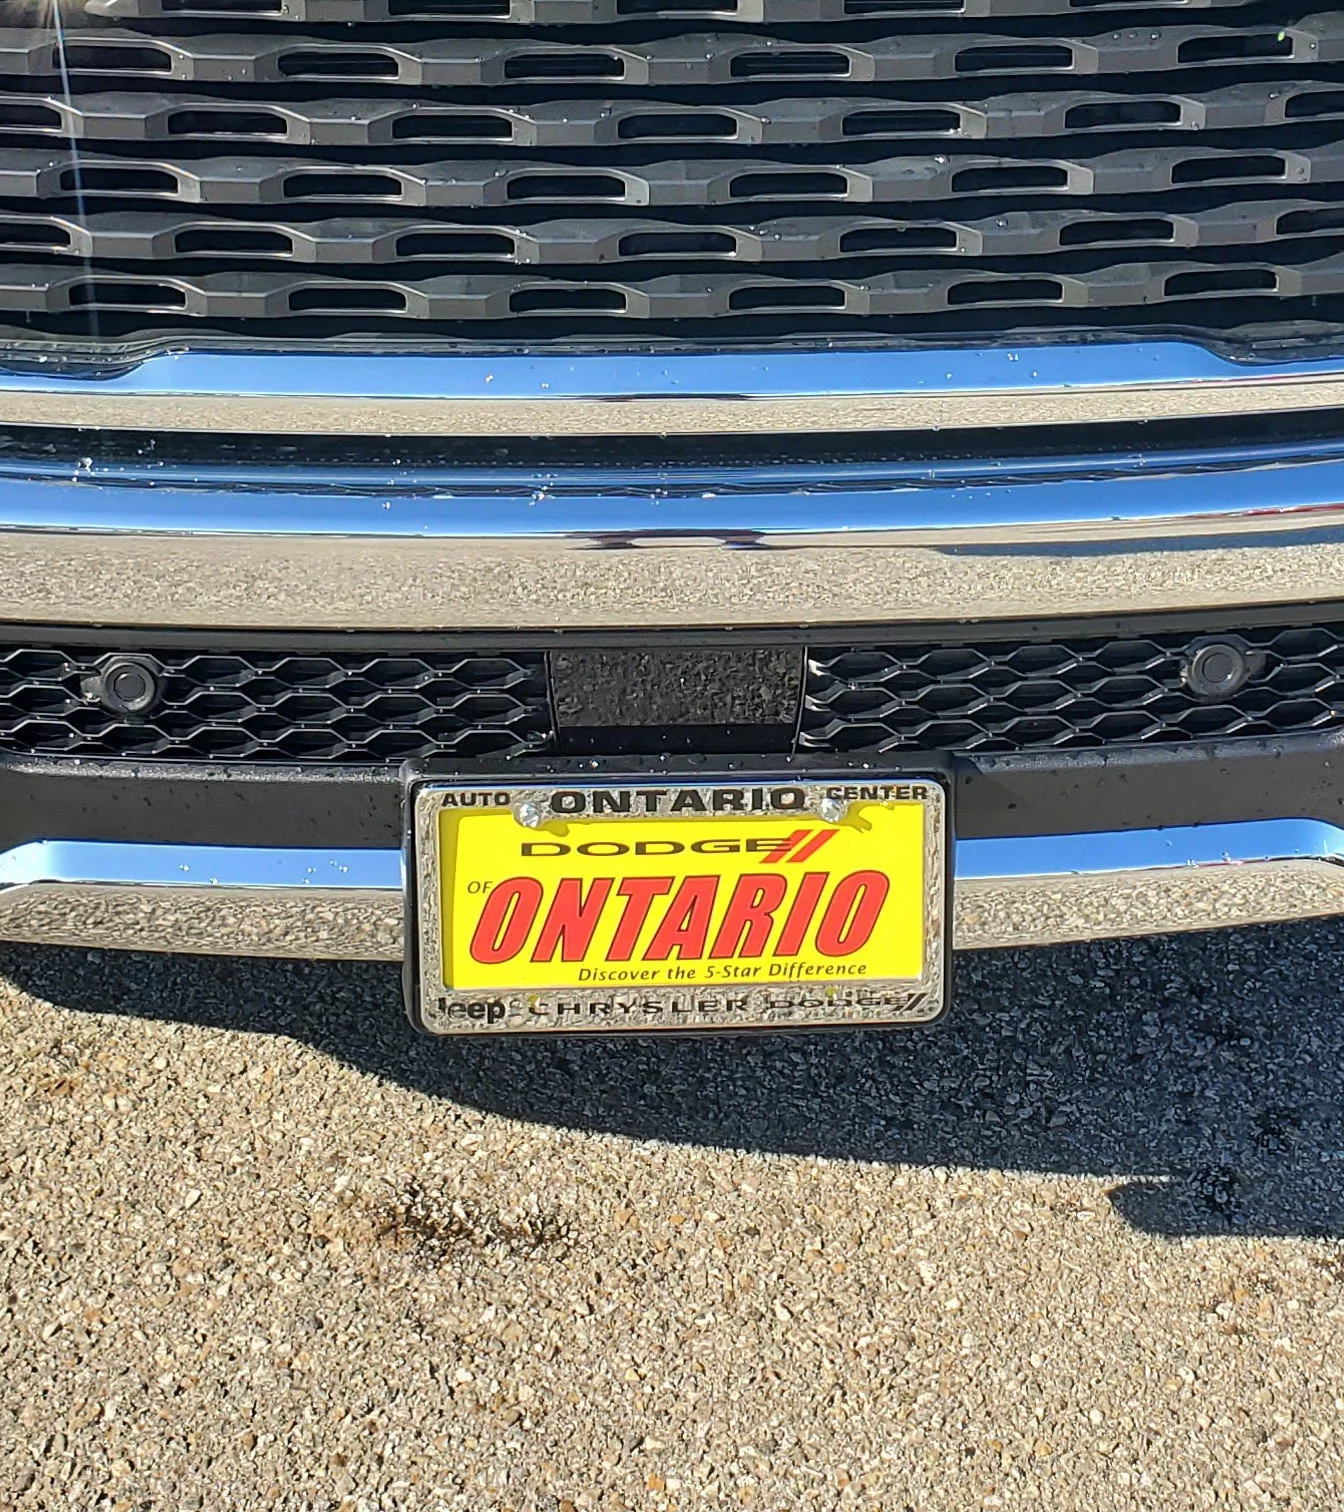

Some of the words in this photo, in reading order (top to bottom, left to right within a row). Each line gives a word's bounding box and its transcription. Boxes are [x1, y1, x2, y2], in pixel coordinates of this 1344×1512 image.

[442, 792, 511, 807] AUTO
[548, 787, 807, 814] ONTARIO
[825, 785, 929, 801] CENTER
[521, 837, 793, 857] DODGE
[467, 880, 493, 896] OF
[469, 869, 891, 965] ONTARIO
[577, 967, 661, 982] Discover
[667, 965, 696, 980] the
[703, 964, 763, 979] 5-Star
[768, 962, 868, 980] Difference
[433, 996, 507, 1025] Jeep
[529, 999, 749, 1016] CHRYSLER
